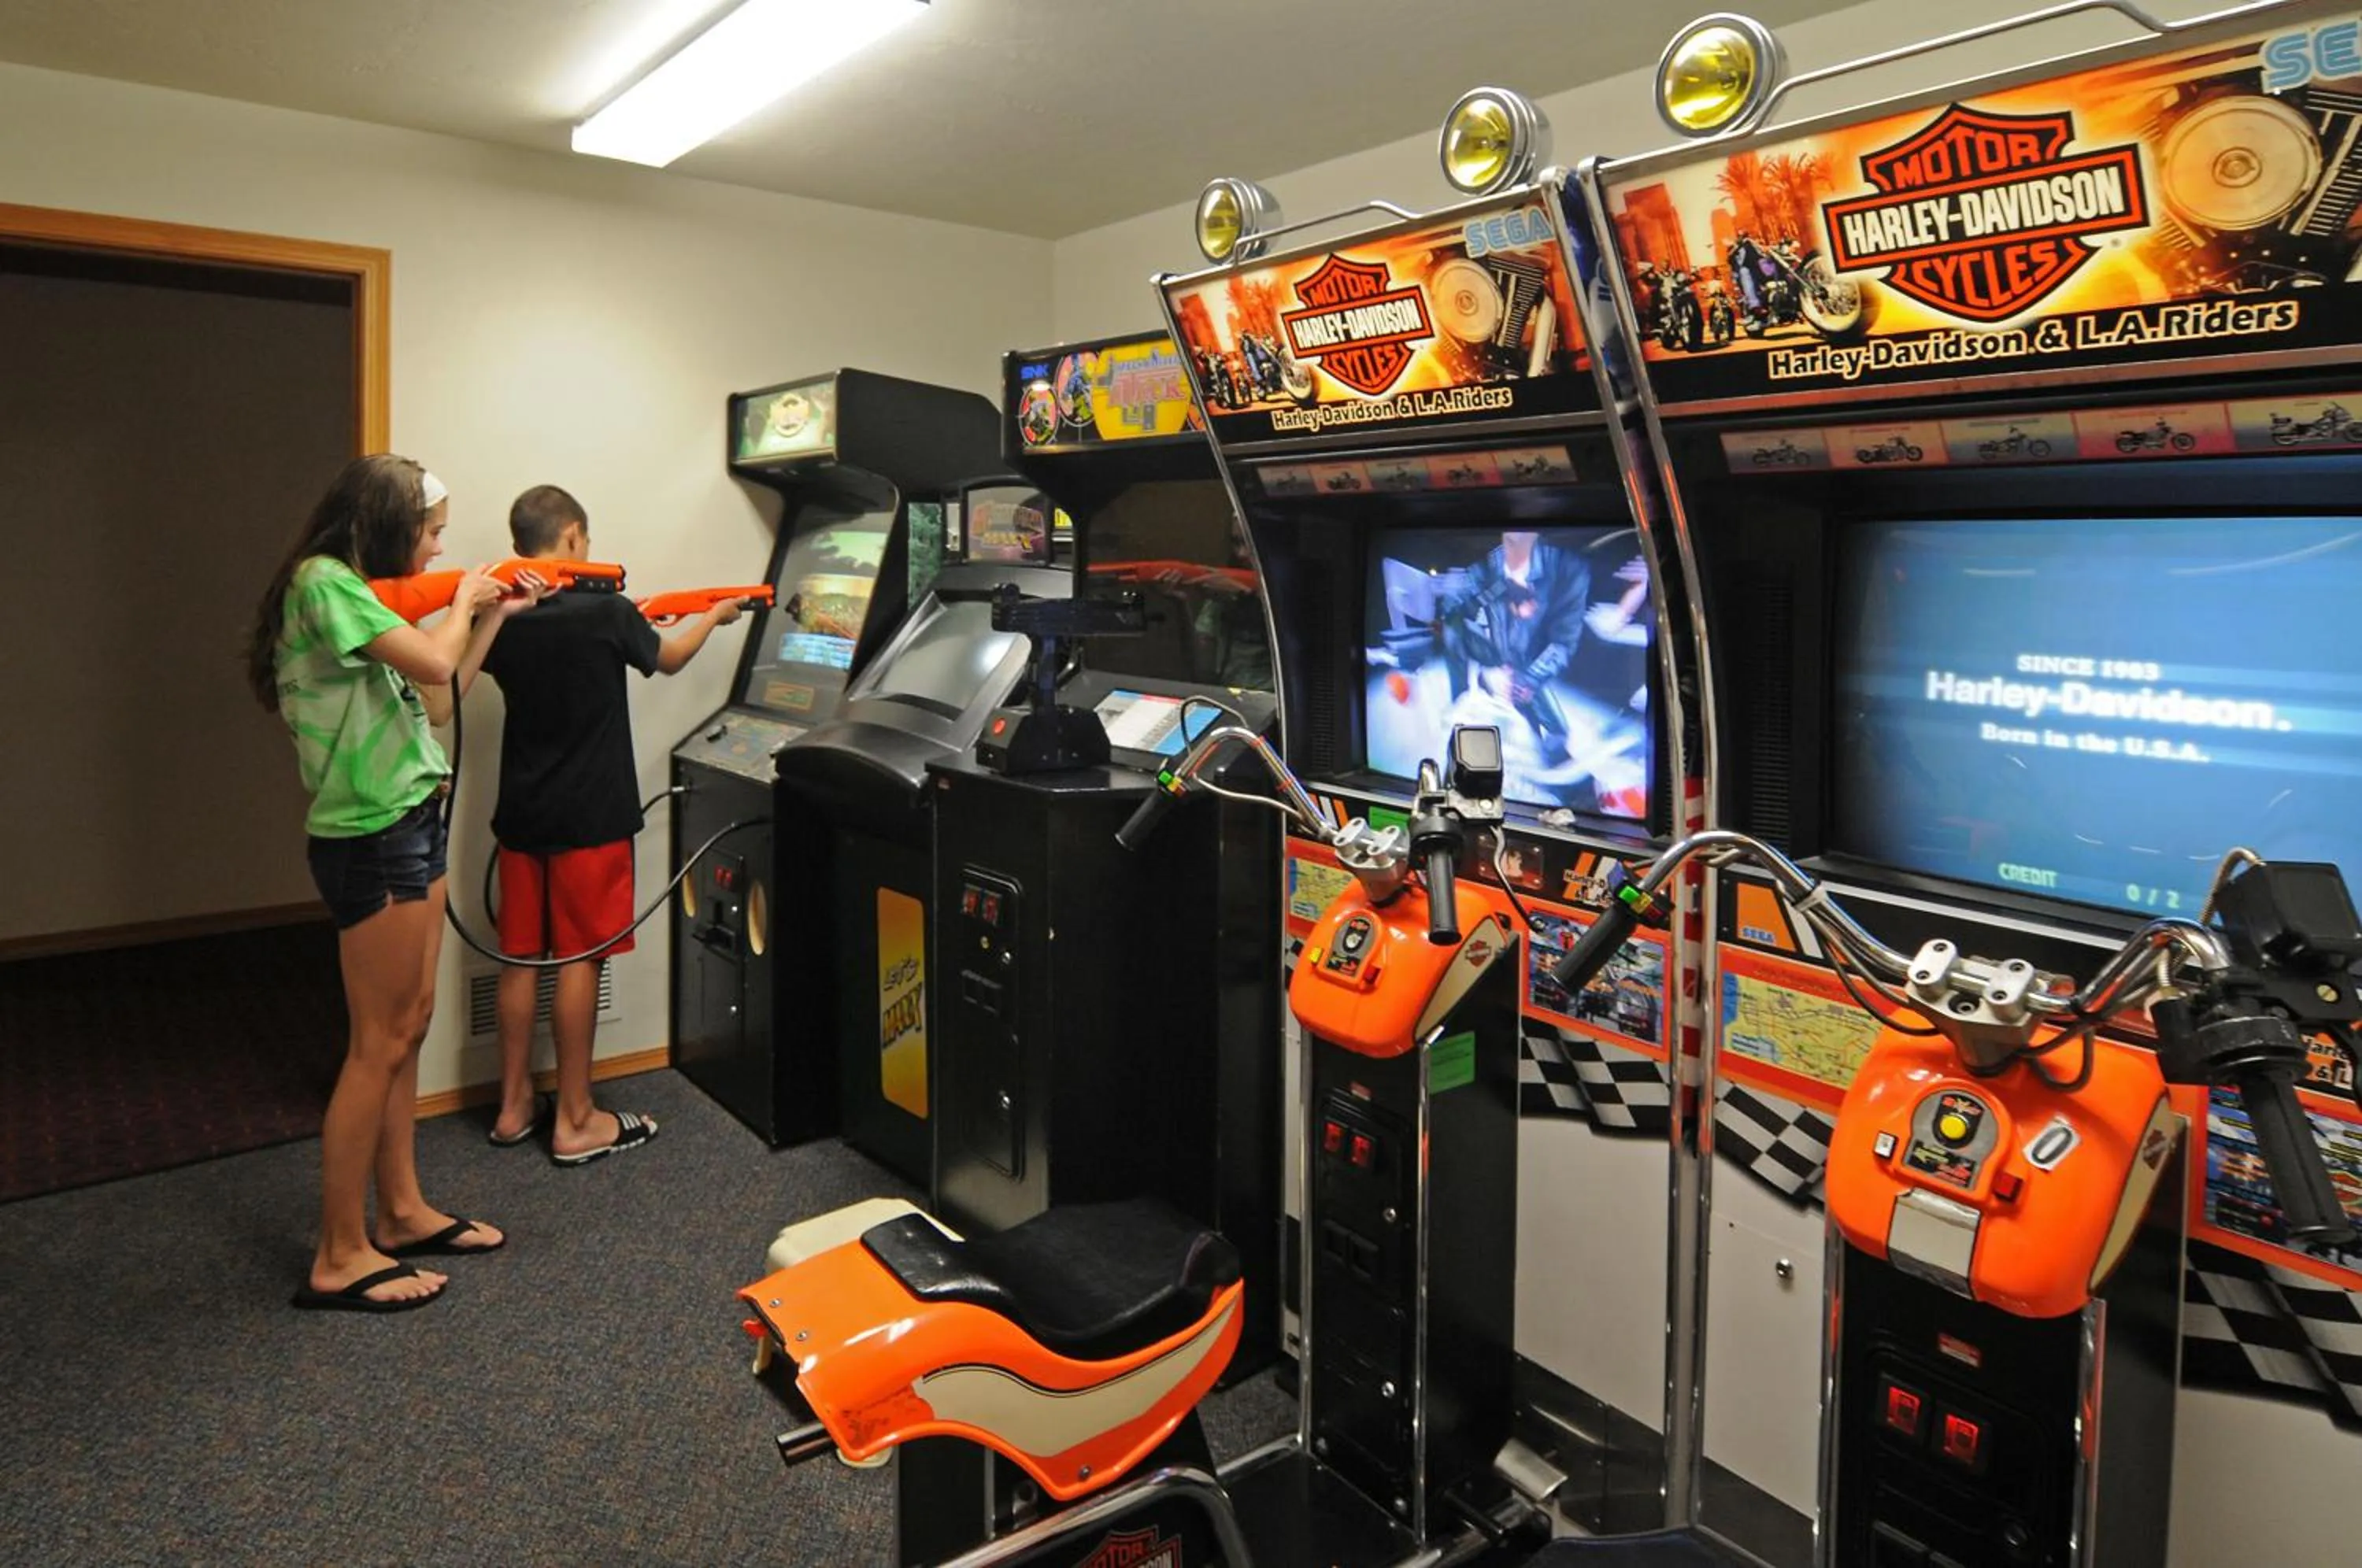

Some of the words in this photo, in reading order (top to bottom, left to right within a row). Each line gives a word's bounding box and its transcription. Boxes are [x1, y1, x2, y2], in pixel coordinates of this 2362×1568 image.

[1893, 124, 2042, 190] MOTOR
[1465, 209, 1553, 256] SEGA
[1842, 166, 2125, 257] HARLEY-DAVIDSON
[1309, 266, 1378, 306] MOTOR
[1911, 240, 2058, 308] CYCLES
[1292, 298, 1423, 349] HARLEY-DAVIDSON
[1331, 342, 1399, 386] CYCLES
[1768, 330, 2027, 379] Harley-Davidson
[2034, 319, 2071, 353] &
[1020, 364, 1050, 380] SNK
[1272, 401, 1394, 432] Harley-Davidson
[1398, 396, 1415, 418] &
[2016, 654, 2094, 676] SINCE
[1980, 722, 2038, 744] Born
[2044, 730, 2069, 748] in
[2075, 733, 2117, 753] the
[2124, 737, 2211, 764] U.S.A.
[1998, 862, 2059, 888] CREDIT
[2166, 889, 2180, 909] 2
[1742, 926, 1775, 943] SEGA
[1085, 1542, 1145, 1568] OTOR
